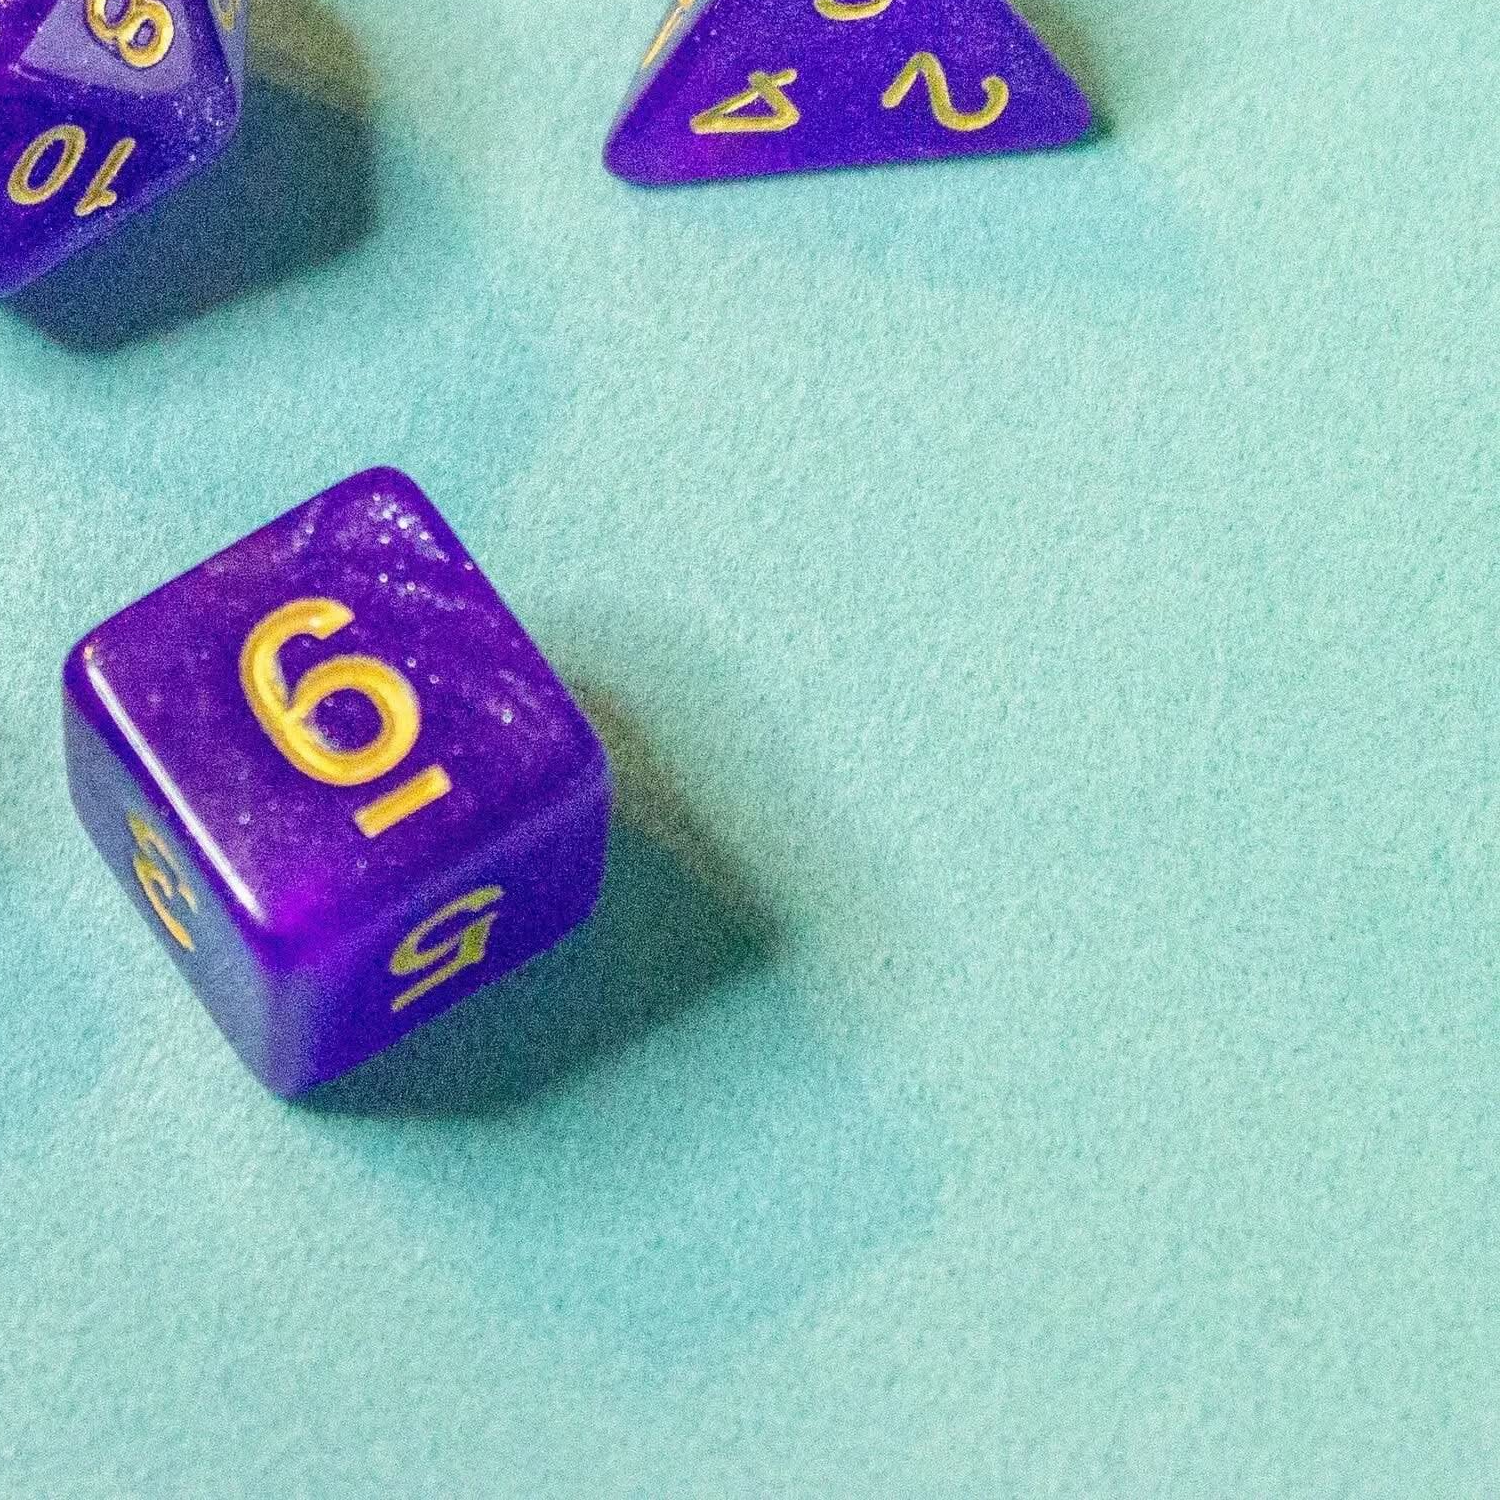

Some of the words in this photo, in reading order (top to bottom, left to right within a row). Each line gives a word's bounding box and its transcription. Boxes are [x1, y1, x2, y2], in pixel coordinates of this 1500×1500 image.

[690, 68, 801, 135] 4
[882, 52, 1010, 132] 2
[7, 123, 137, 217] 10
[389, 885, 505, 1012] 5
